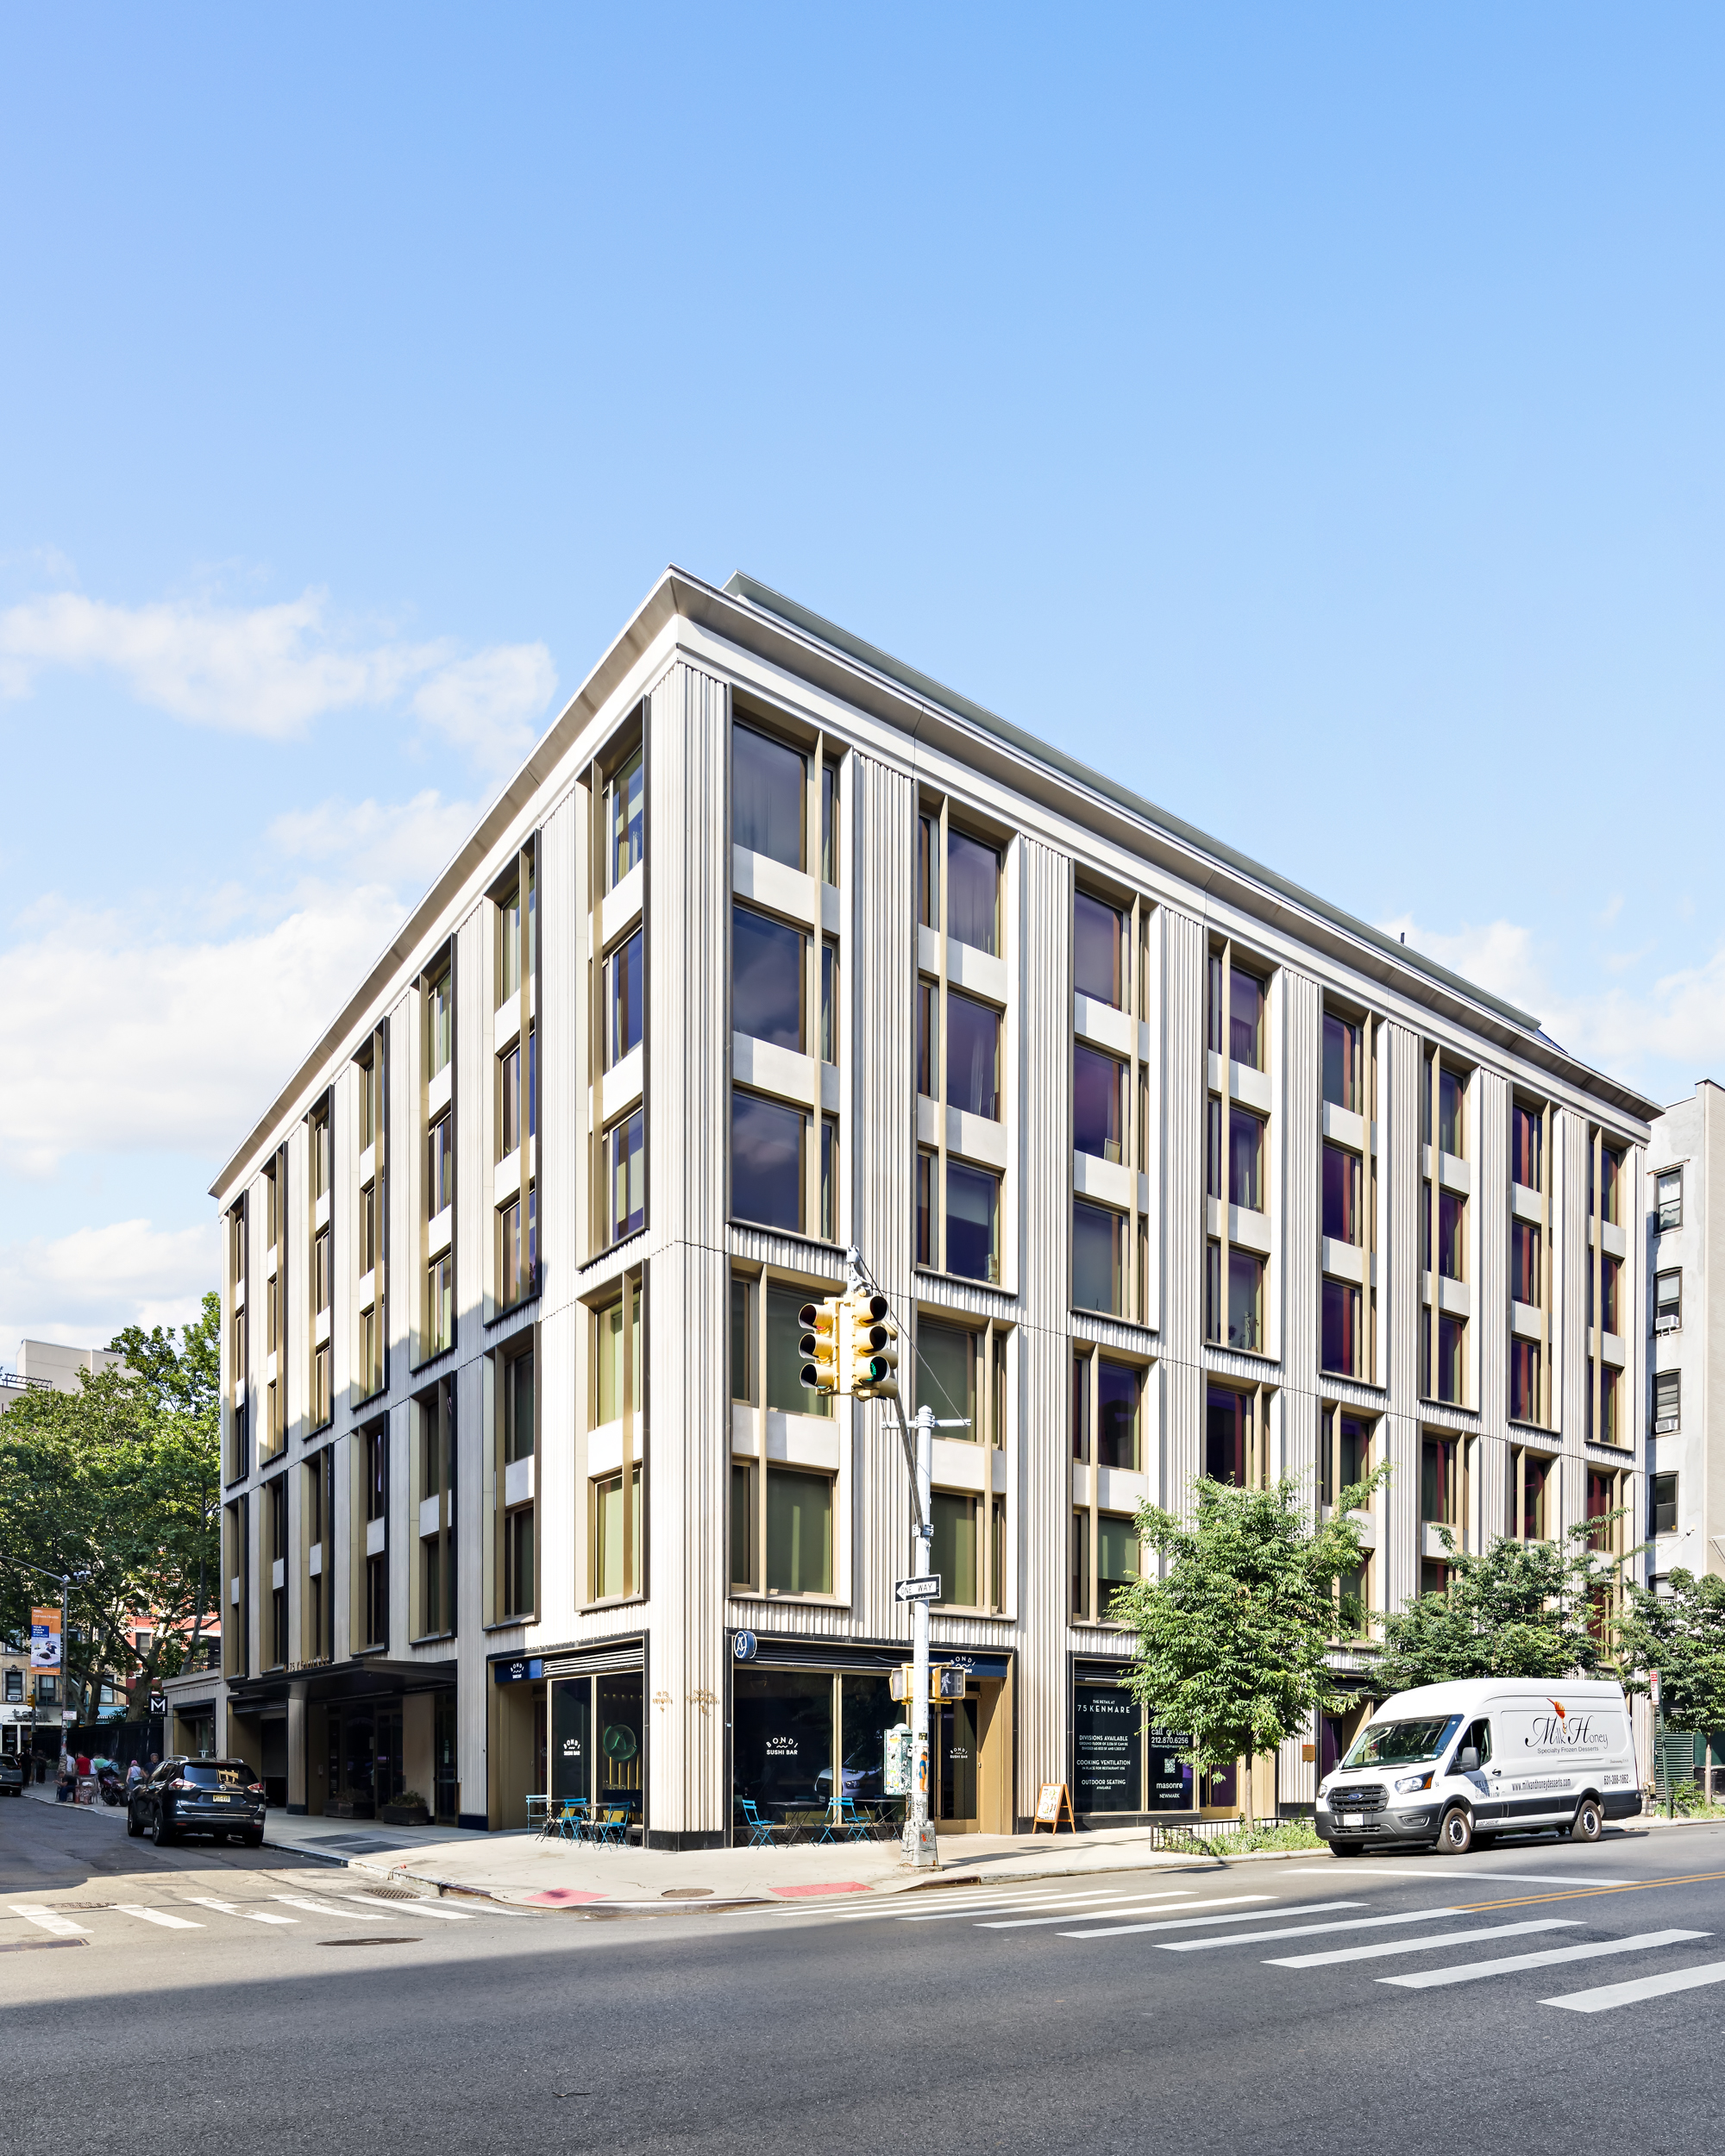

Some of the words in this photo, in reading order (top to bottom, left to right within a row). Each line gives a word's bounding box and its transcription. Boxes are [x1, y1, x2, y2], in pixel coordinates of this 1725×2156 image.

[901, 1586, 913, 1595] ONE
[918, 1583, 932, 1592] WAY
[950, 1656, 976, 1666] BONDI
[151, 1698, 166, 1712] M
[1525, 1715, 1566, 1747] Milk
[1567, 1715, 1609, 1749] Honey
[563, 1739, 580, 1749] BONDI
[766, 1736, 799, 1748] BONDI
[1511, 1778, 1571, 1791] www.milkandhoneydesserts.com
[1603, 1774, 1629, 1785] 631-388-1862
